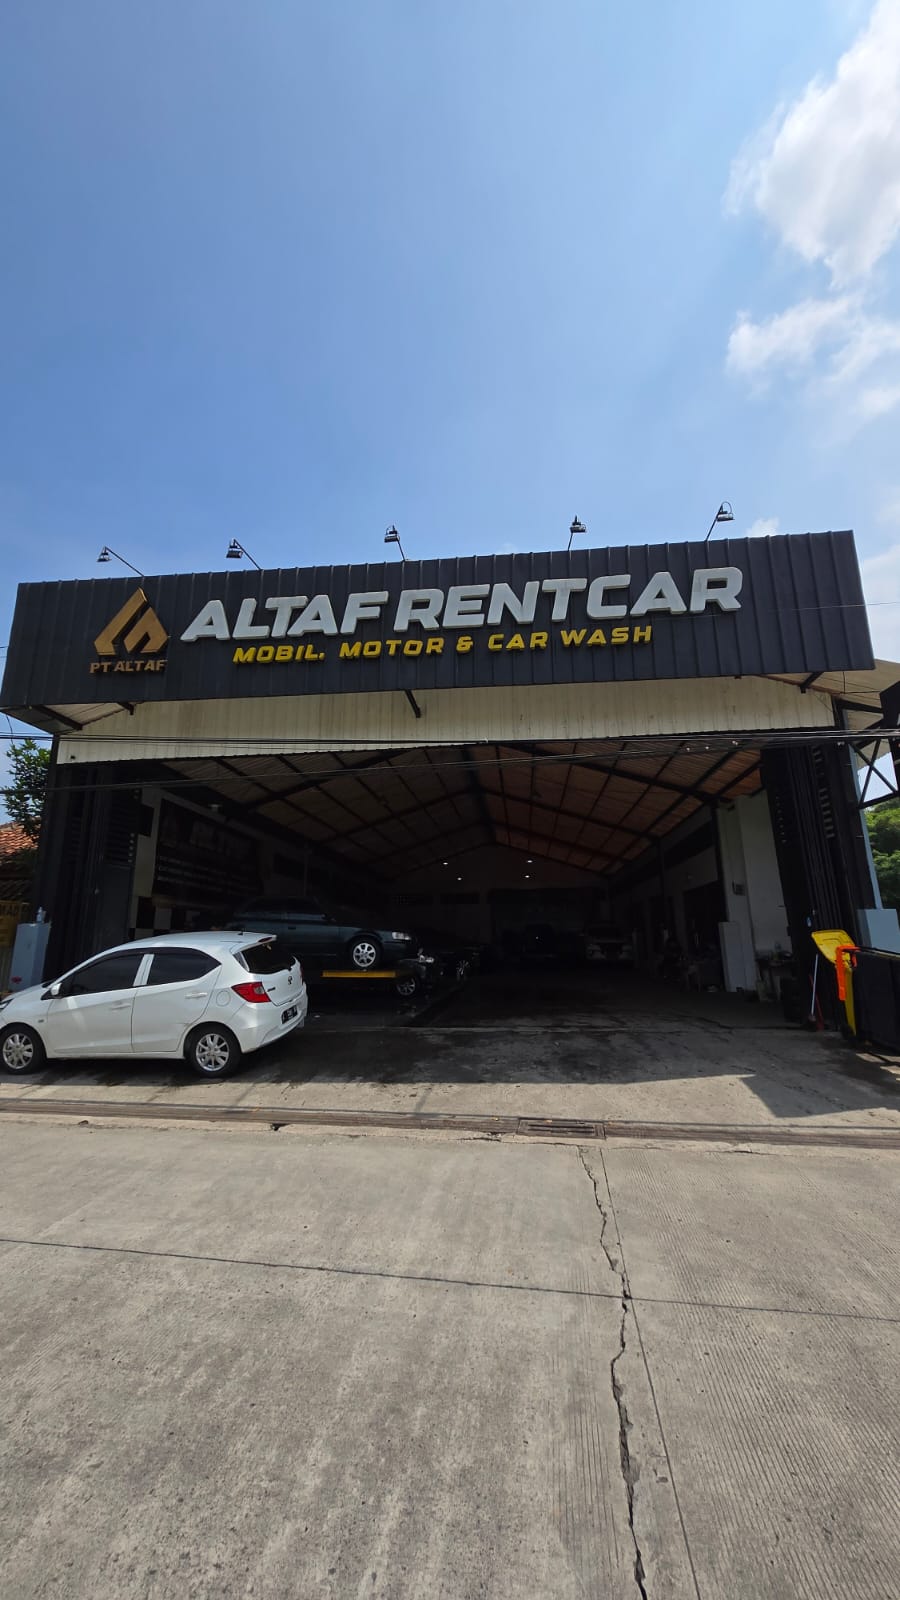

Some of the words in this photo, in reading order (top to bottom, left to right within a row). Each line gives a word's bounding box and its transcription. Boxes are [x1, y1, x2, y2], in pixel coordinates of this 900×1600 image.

[180, 590, 389, 643] ALTAF
[393, 566, 744, 633] RENTCAR
[339, 637, 444, 659] MOTOR
[456, 636, 474, 654] &
[487, 631, 548, 652] CAR
[560, 624, 653, 647] WASH
[89, 661, 112, 674] PT
[113, 659, 168, 673] ALTAF
